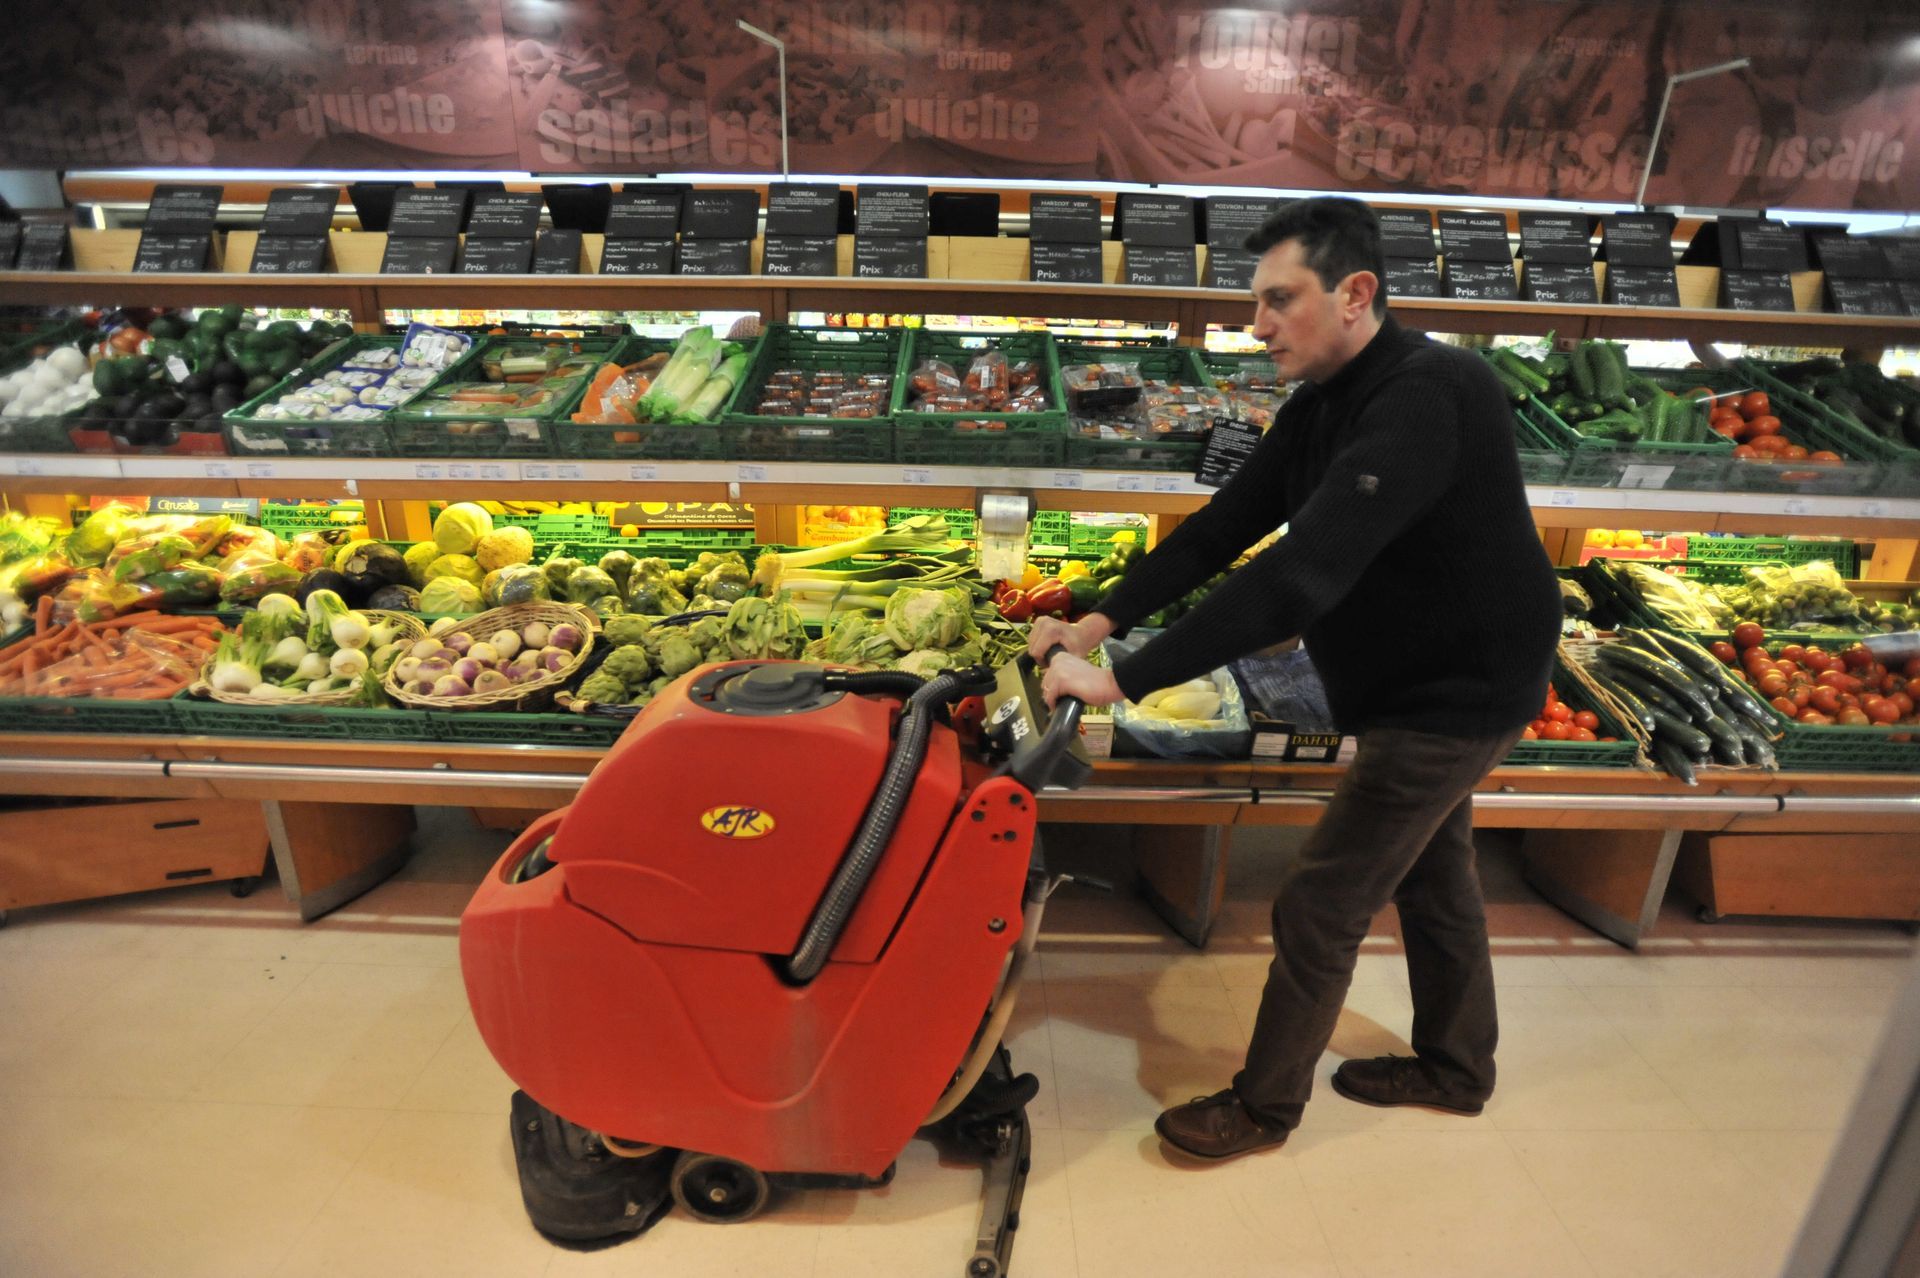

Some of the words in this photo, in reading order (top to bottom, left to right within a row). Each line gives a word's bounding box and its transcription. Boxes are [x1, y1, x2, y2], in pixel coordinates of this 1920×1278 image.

[1174, 14, 1361, 80] rouget
[344, 42, 418, 66] terrine
[937, 46, 1012, 71] terrine
[299, 86, 456, 139] quiche
[874, 91, 1039, 142] quiche
[536, 99, 783, 166] salades
[139, 260, 164, 270] Prix:
[387, 262, 410, 271] Prix:
[464, 262, 489, 272] Prix:
[605, 263, 630, 272] Prix:
[681, 264, 706, 273] Prix:
[768, 263, 793, 273] Prix:
[859, 264, 884, 274] Prix:
[1036, 269, 1062, 280] Prix:
[1131, 272, 1157, 283] Prix:
[1216, 276, 1241, 287] Prix:
[1455, 287, 1479, 297] Prix:
[1535, 290, 1559, 300] Prix:
[1011, 717, 1030, 741] 532
[1291, 735, 1340, 745] DAHAB
[711, 807, 762, 837] AJR
